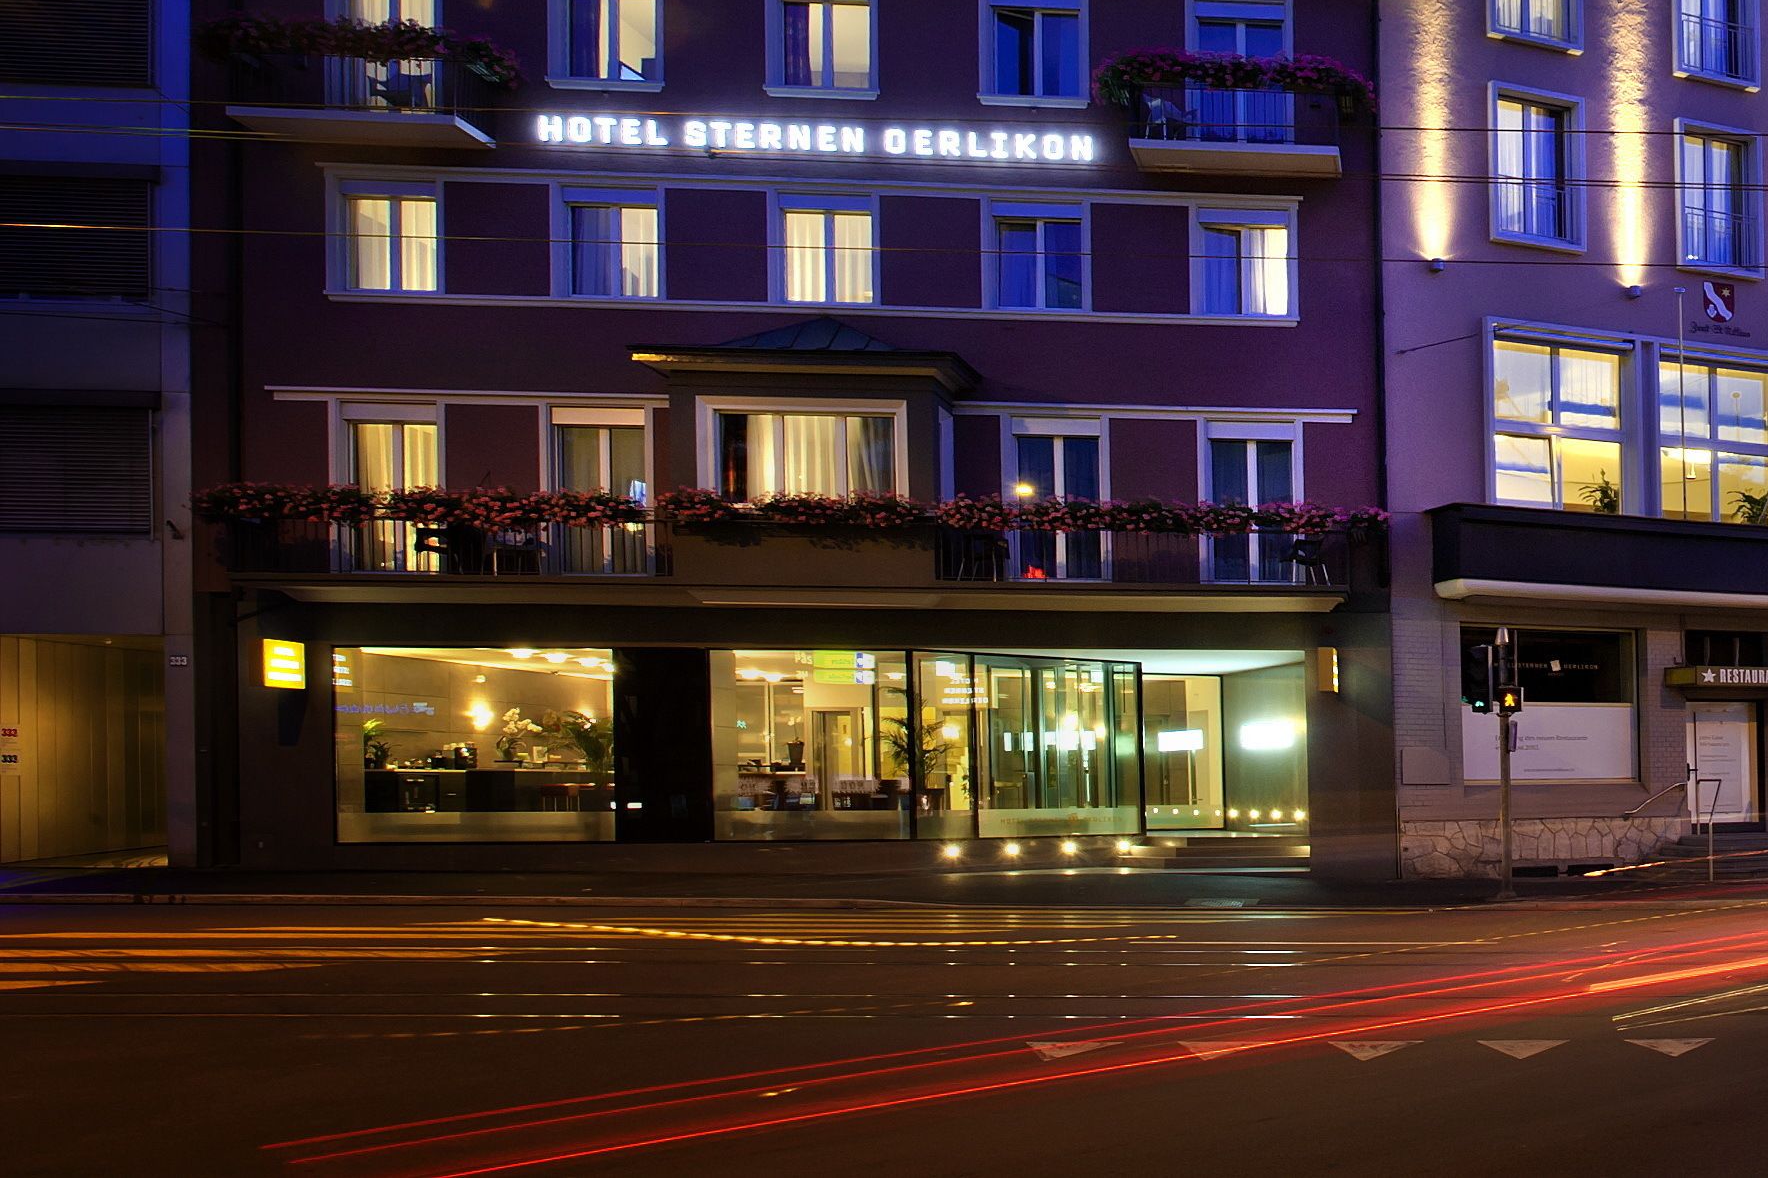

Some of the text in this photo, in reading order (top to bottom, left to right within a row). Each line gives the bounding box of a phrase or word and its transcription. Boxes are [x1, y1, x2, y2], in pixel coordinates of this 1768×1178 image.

[537, 115, 1094, 161] HOTEL STERNEN OERLIKON
